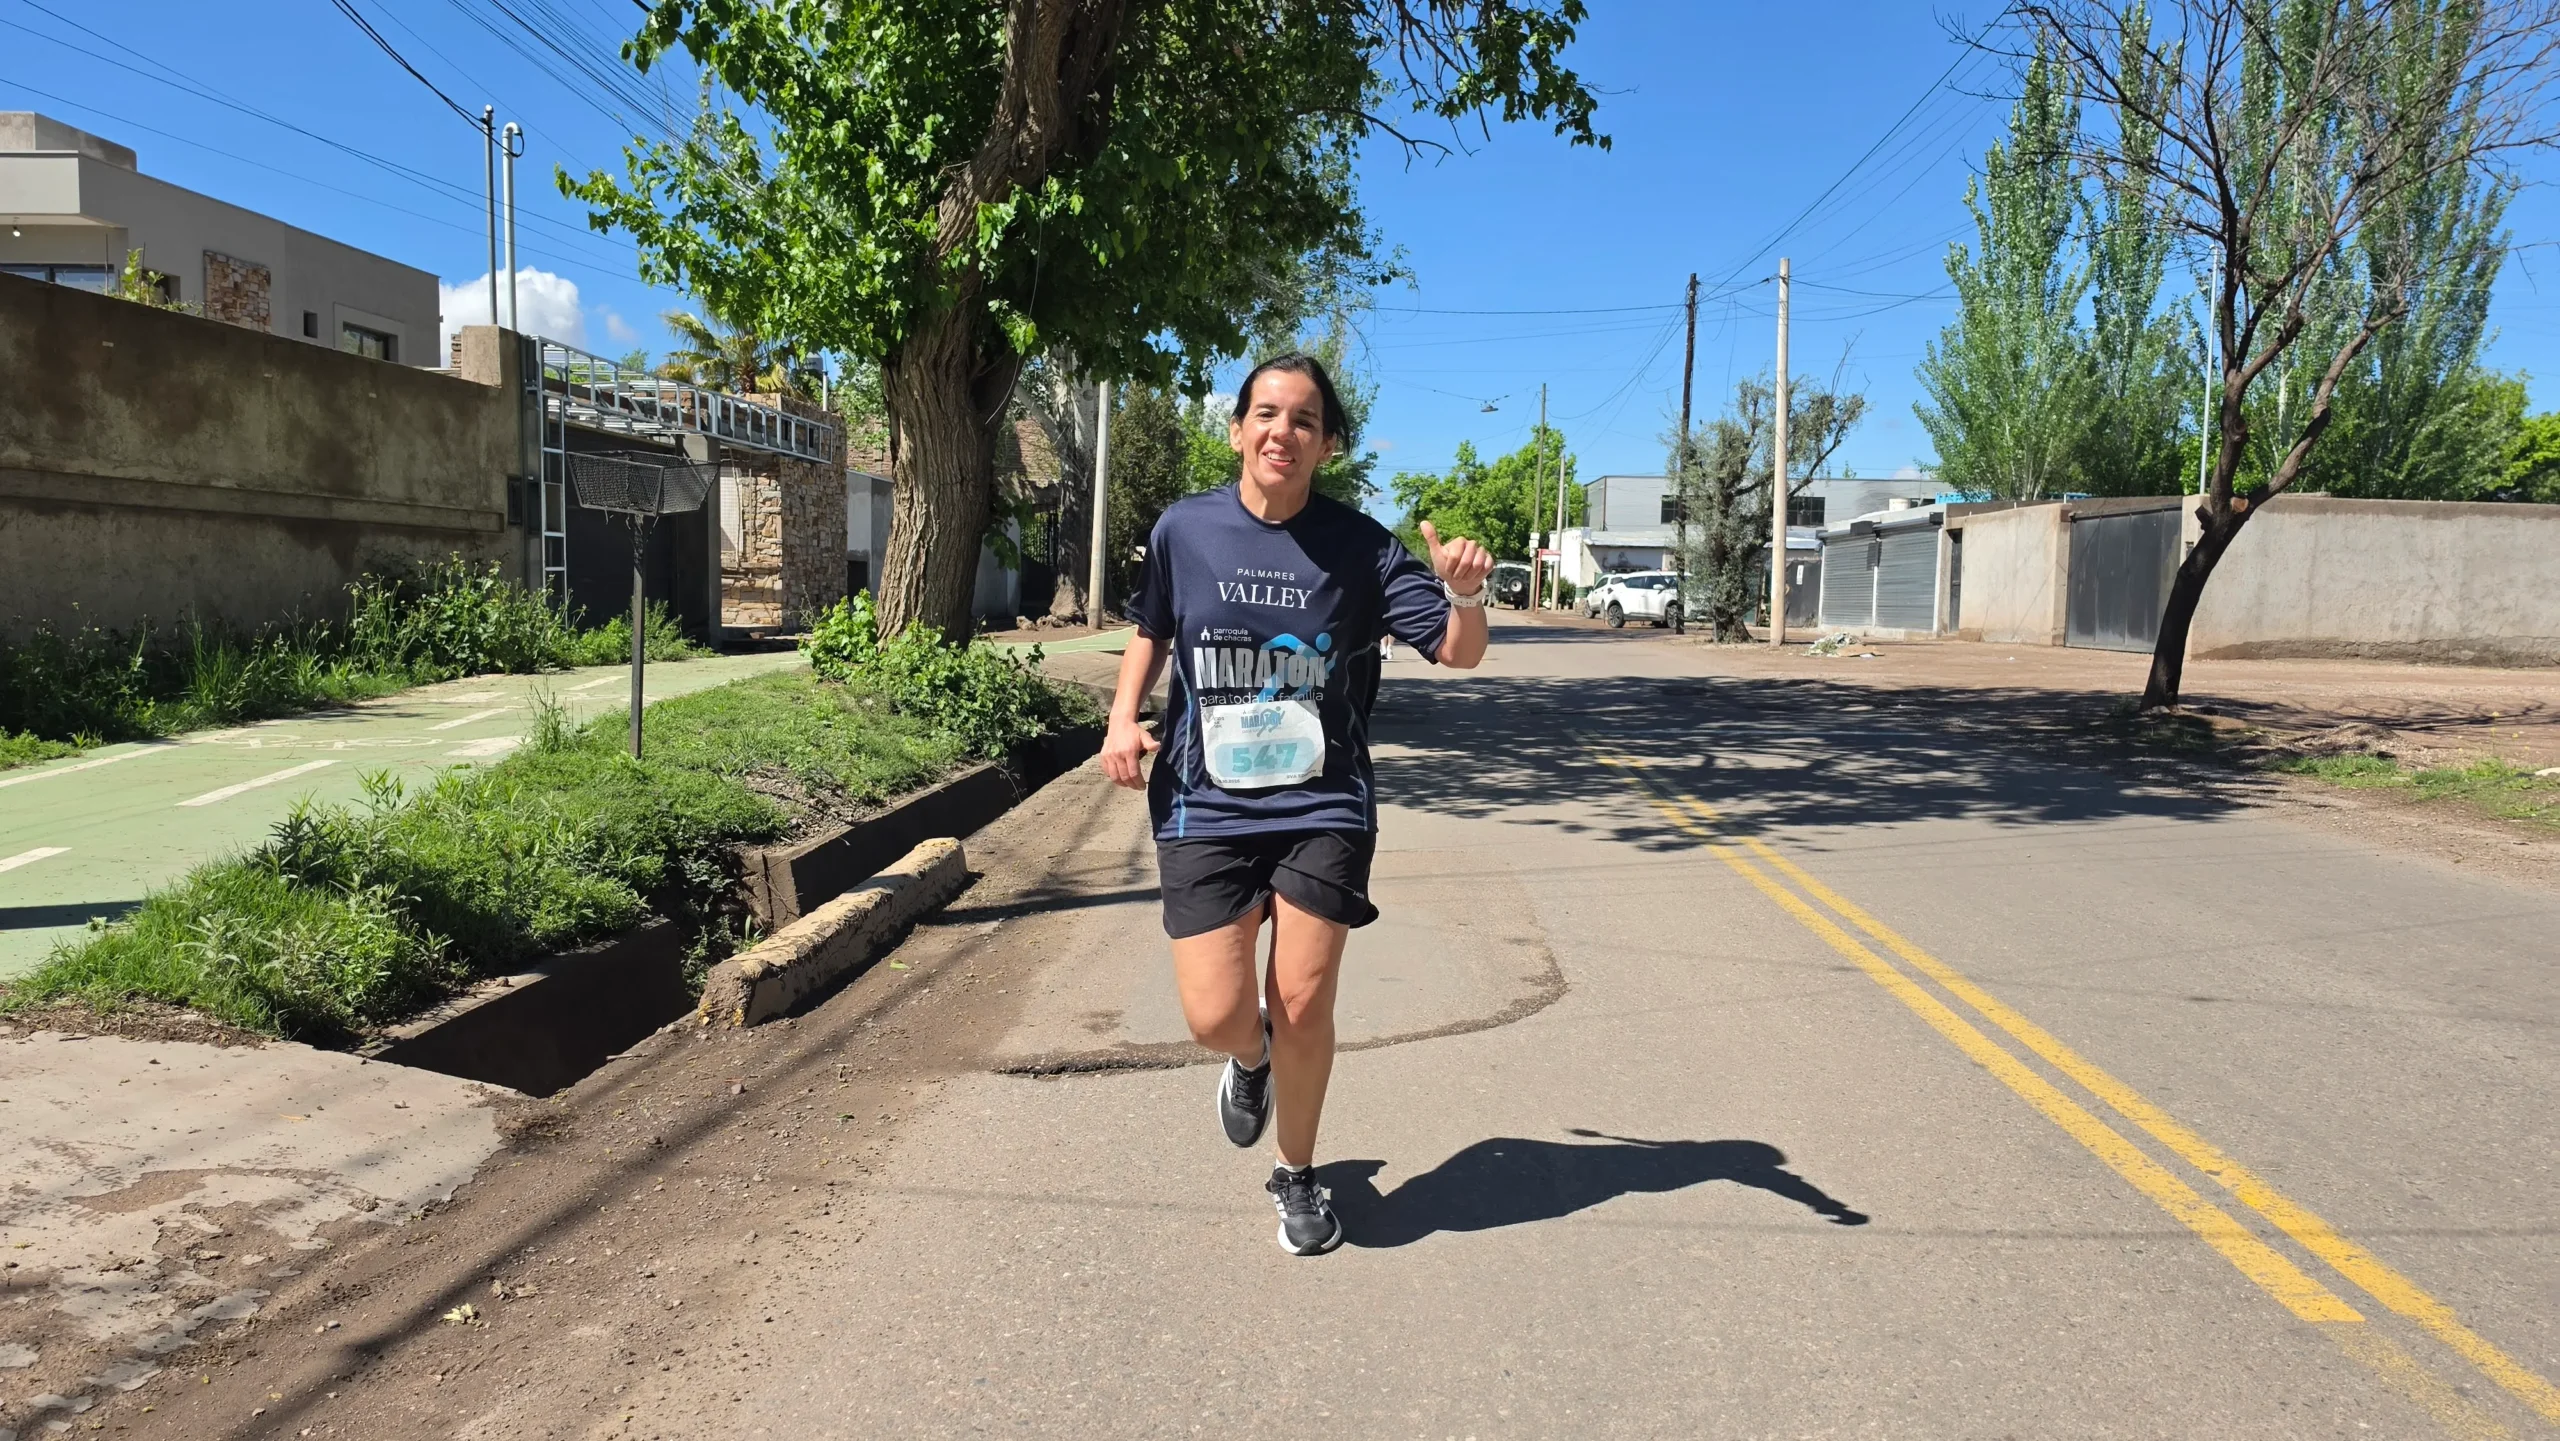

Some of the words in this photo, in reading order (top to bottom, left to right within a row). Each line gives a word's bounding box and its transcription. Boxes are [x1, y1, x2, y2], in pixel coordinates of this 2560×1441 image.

[1236, 568, 1295, 580] PALMARES
[1217, 581, 1312, 609] VALLEY
[1199, 694, 1226, 707] para
[1228, 691, 1259, 704] toda
[1263, 691, 1274, 703] la
[1278, 689, 1323, 702] familia
[1232, 743, 1297, 772] 547
